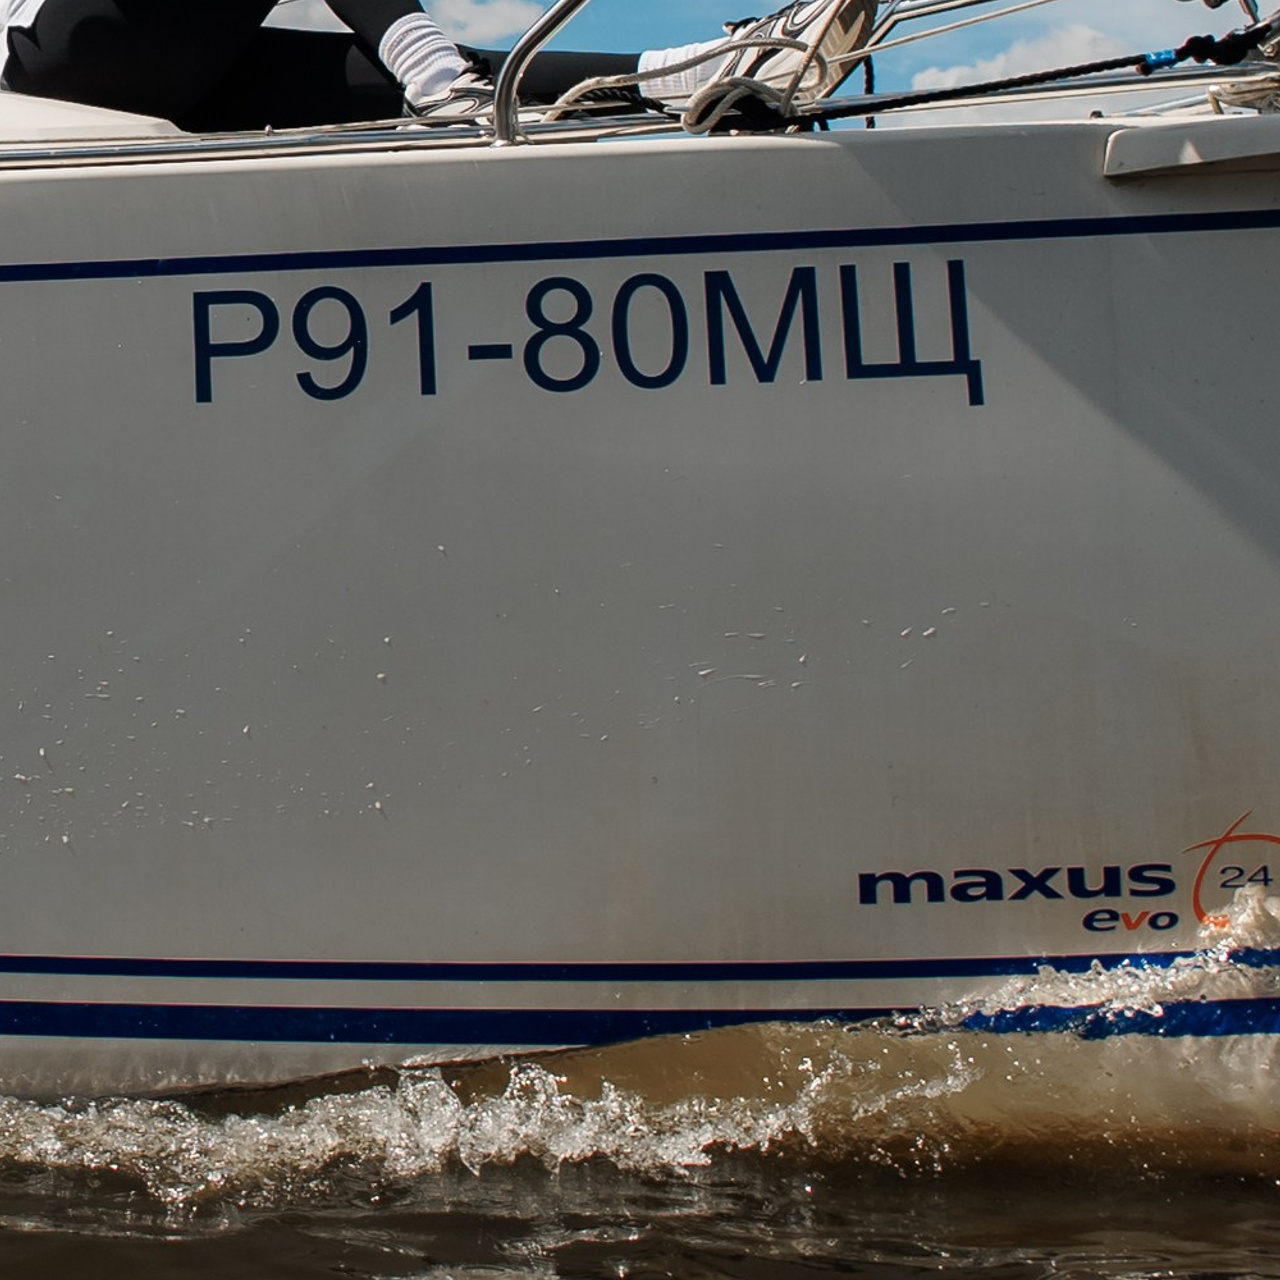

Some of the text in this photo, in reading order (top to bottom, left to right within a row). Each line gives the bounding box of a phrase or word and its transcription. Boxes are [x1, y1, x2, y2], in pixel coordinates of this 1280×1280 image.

[193, 259, 985, 405] Р91-80МЩ
[858, 863, 1176, 905] maxus
[1220, 864, 1274, 888] 24
[1082, 908, 1179, 932] evo
